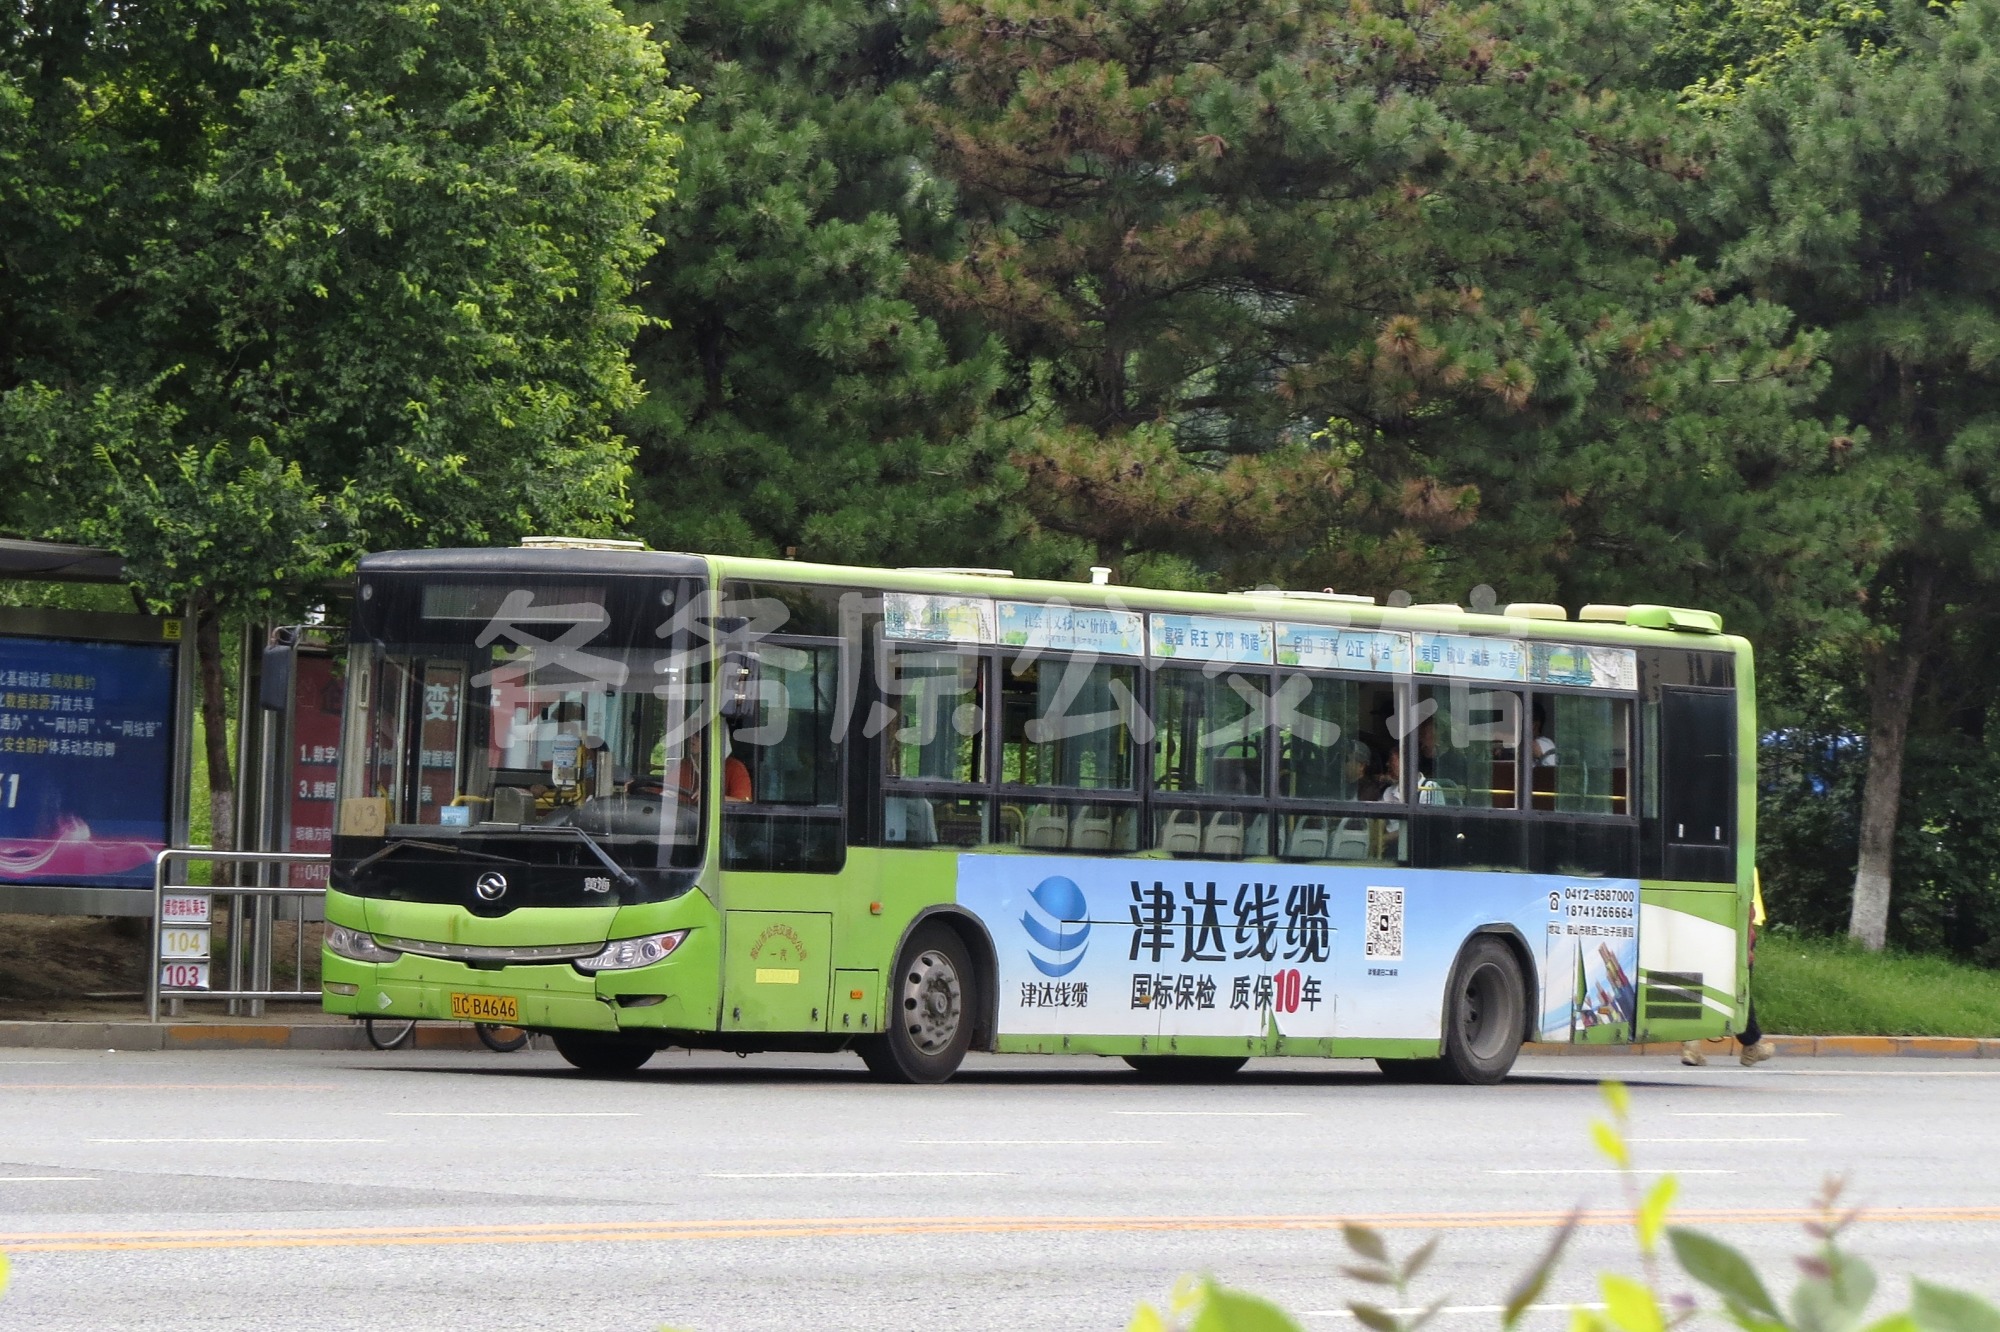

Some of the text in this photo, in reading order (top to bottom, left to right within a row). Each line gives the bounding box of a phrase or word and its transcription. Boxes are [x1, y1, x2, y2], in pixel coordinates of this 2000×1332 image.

[1024, 612, 1123, 635] 社会主义核心价值观
[1165, 626, 1259, 651] 富强 民主 文明 和谐
[1320, 638, 1339, 656] 平等
[1345, 639, 1366, 658] 公正
[1421, 645, 1441, 663] 爱国
[1446, 647, 1466, 665] 敬业
[1499, 650, 1518, 670] 友善
[584, 877, 610, 892] 黄海
[1565, 888, 1634, 902] 0412-8587000
[1129, 880, 1331, 963] 津达线缆
[1565, 905, 1633, 918] 18741266664
[168, 932, 200, 952] 104
[166, 965, 199, 987] 103
[1020, 982, 1089, 1008] 津达线缆
[1130, 973, 1217, 1010] 国标保检
[1229, 968, 1322, 1013] 质保10年
